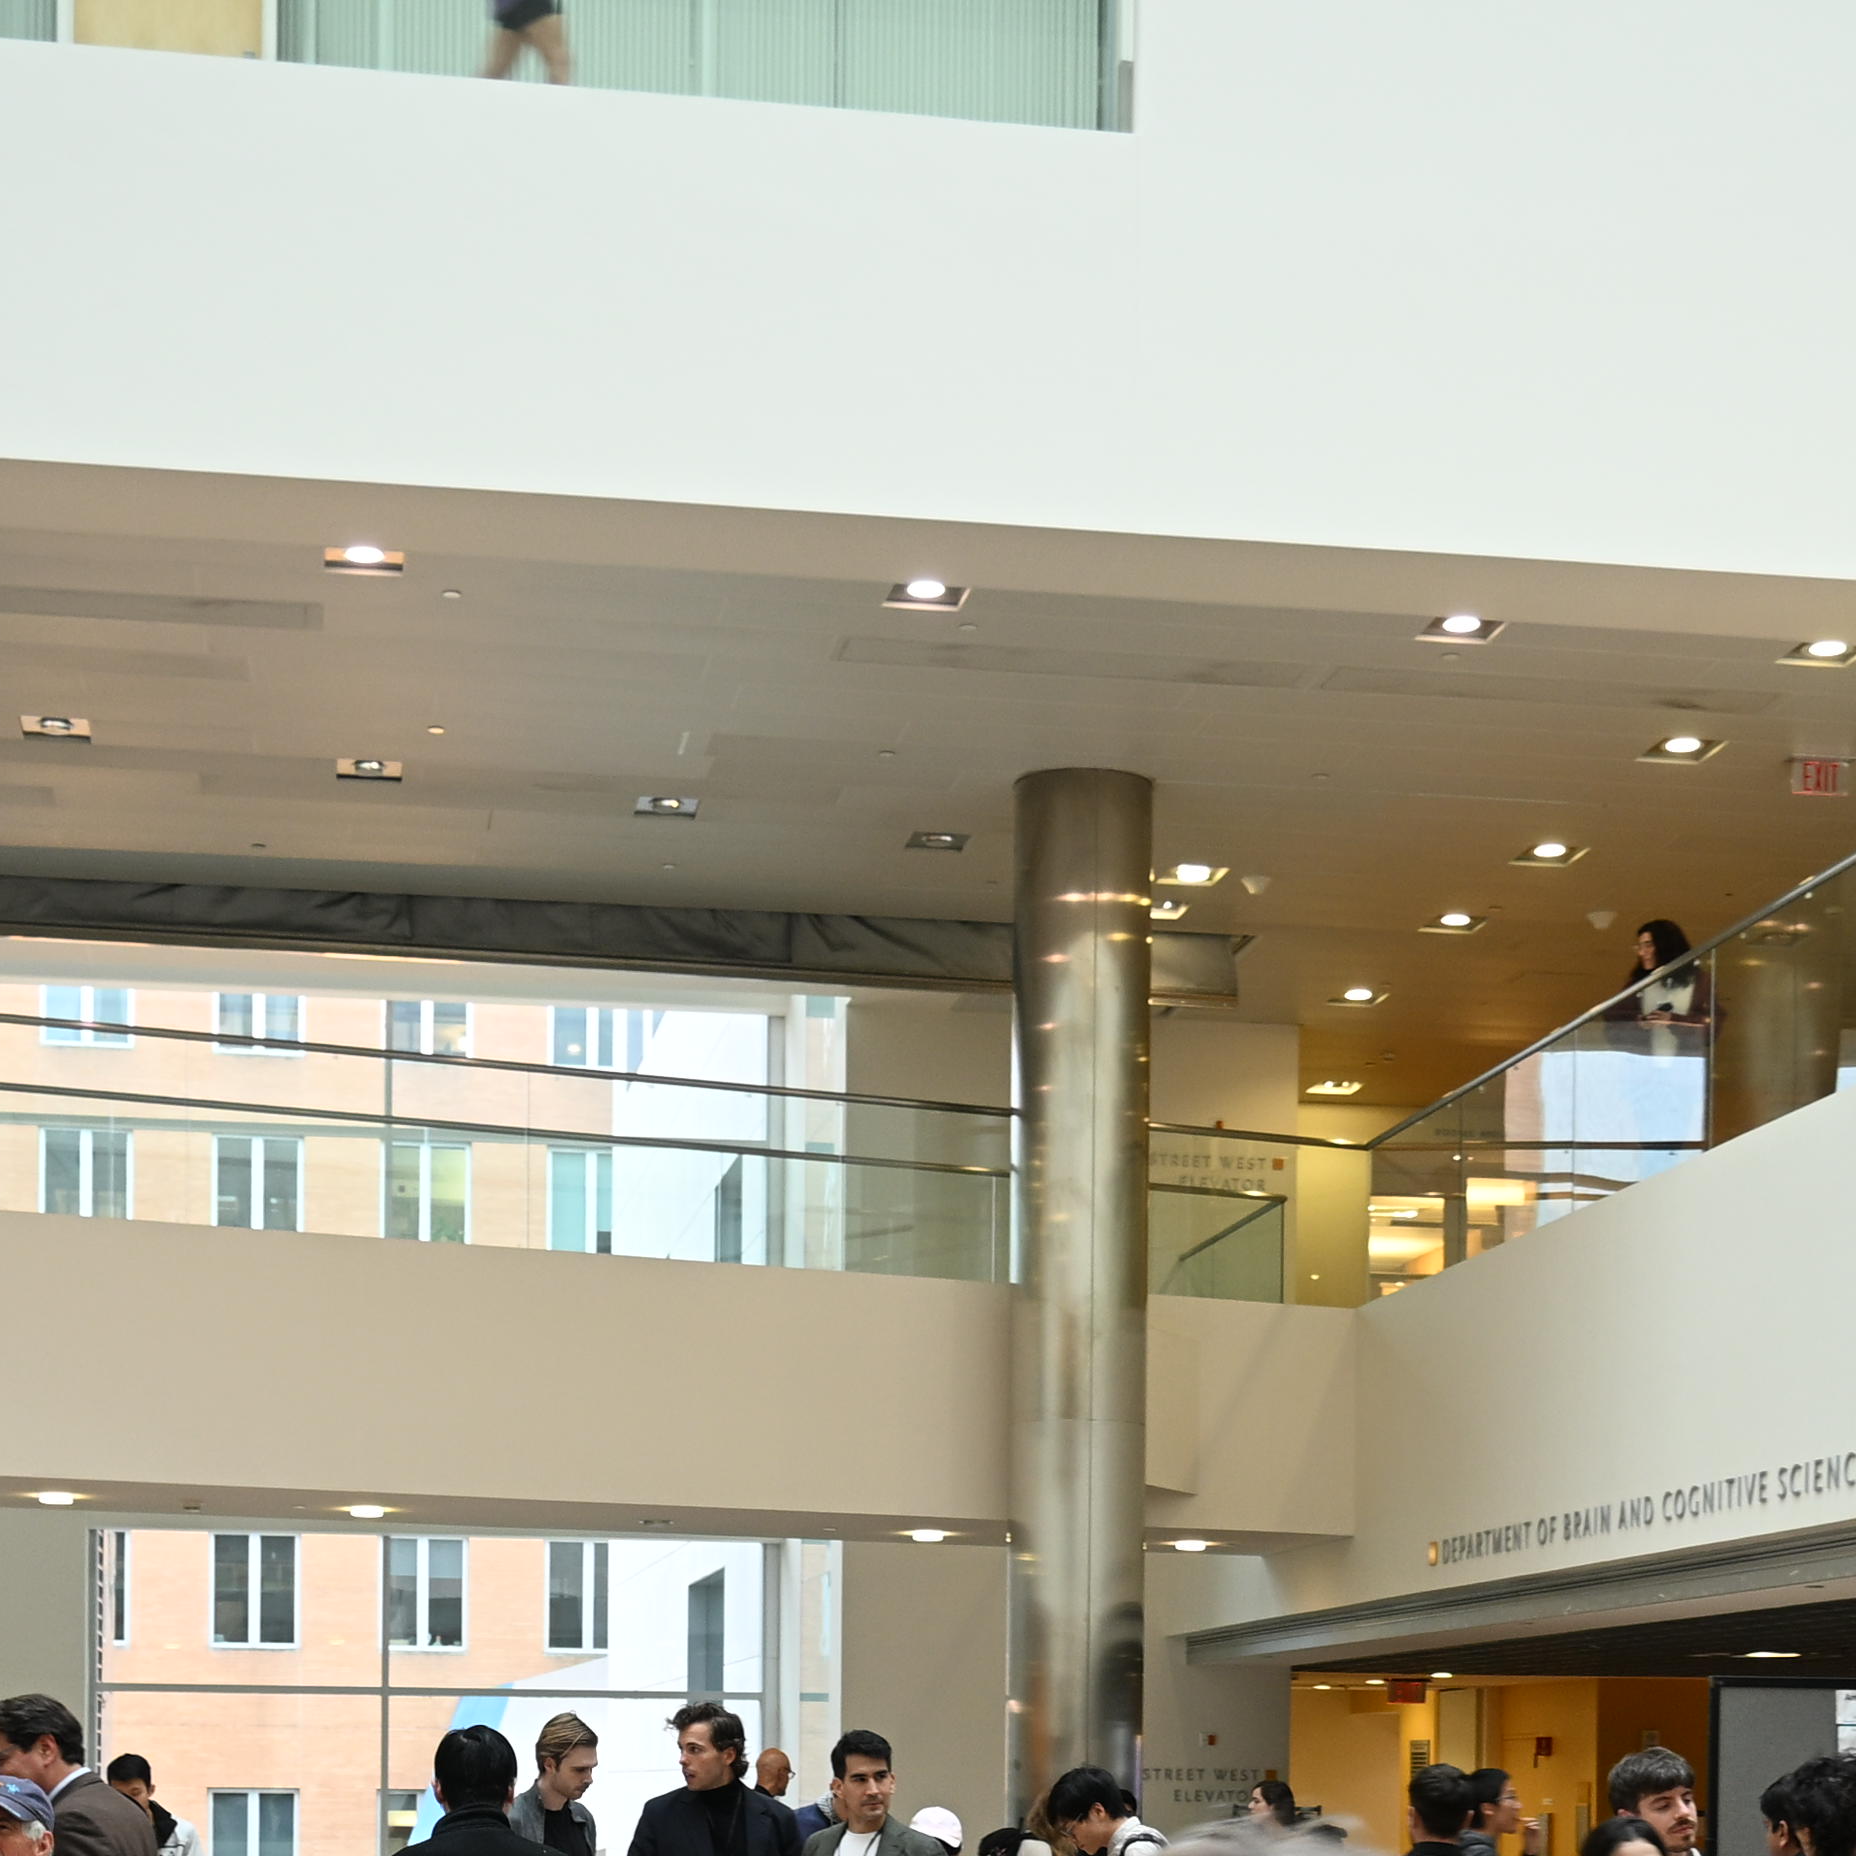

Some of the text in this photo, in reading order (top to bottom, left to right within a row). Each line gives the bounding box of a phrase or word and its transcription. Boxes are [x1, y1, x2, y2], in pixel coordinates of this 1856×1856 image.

[1802, 761, 1840, 792] EXIT
[1219, 1156, 1266, 1170] WEST
[1178, 1176, 1265, 1191] ELEVATOR
[1442, 1520, 1532, 1565] DEPARTMENT
[1537, 1515, 1557, 1546] OF
[1564, 1504, 1611, 1542] BRAIN
[1618, 1495, 1654, 1531] AND
[1662, 1470, 1768, 1522] COGNITIVE
[1143, 1767, 1260, 1781] STREET WEST
[1173, 1789, 1249, 1803] ELEVATO
